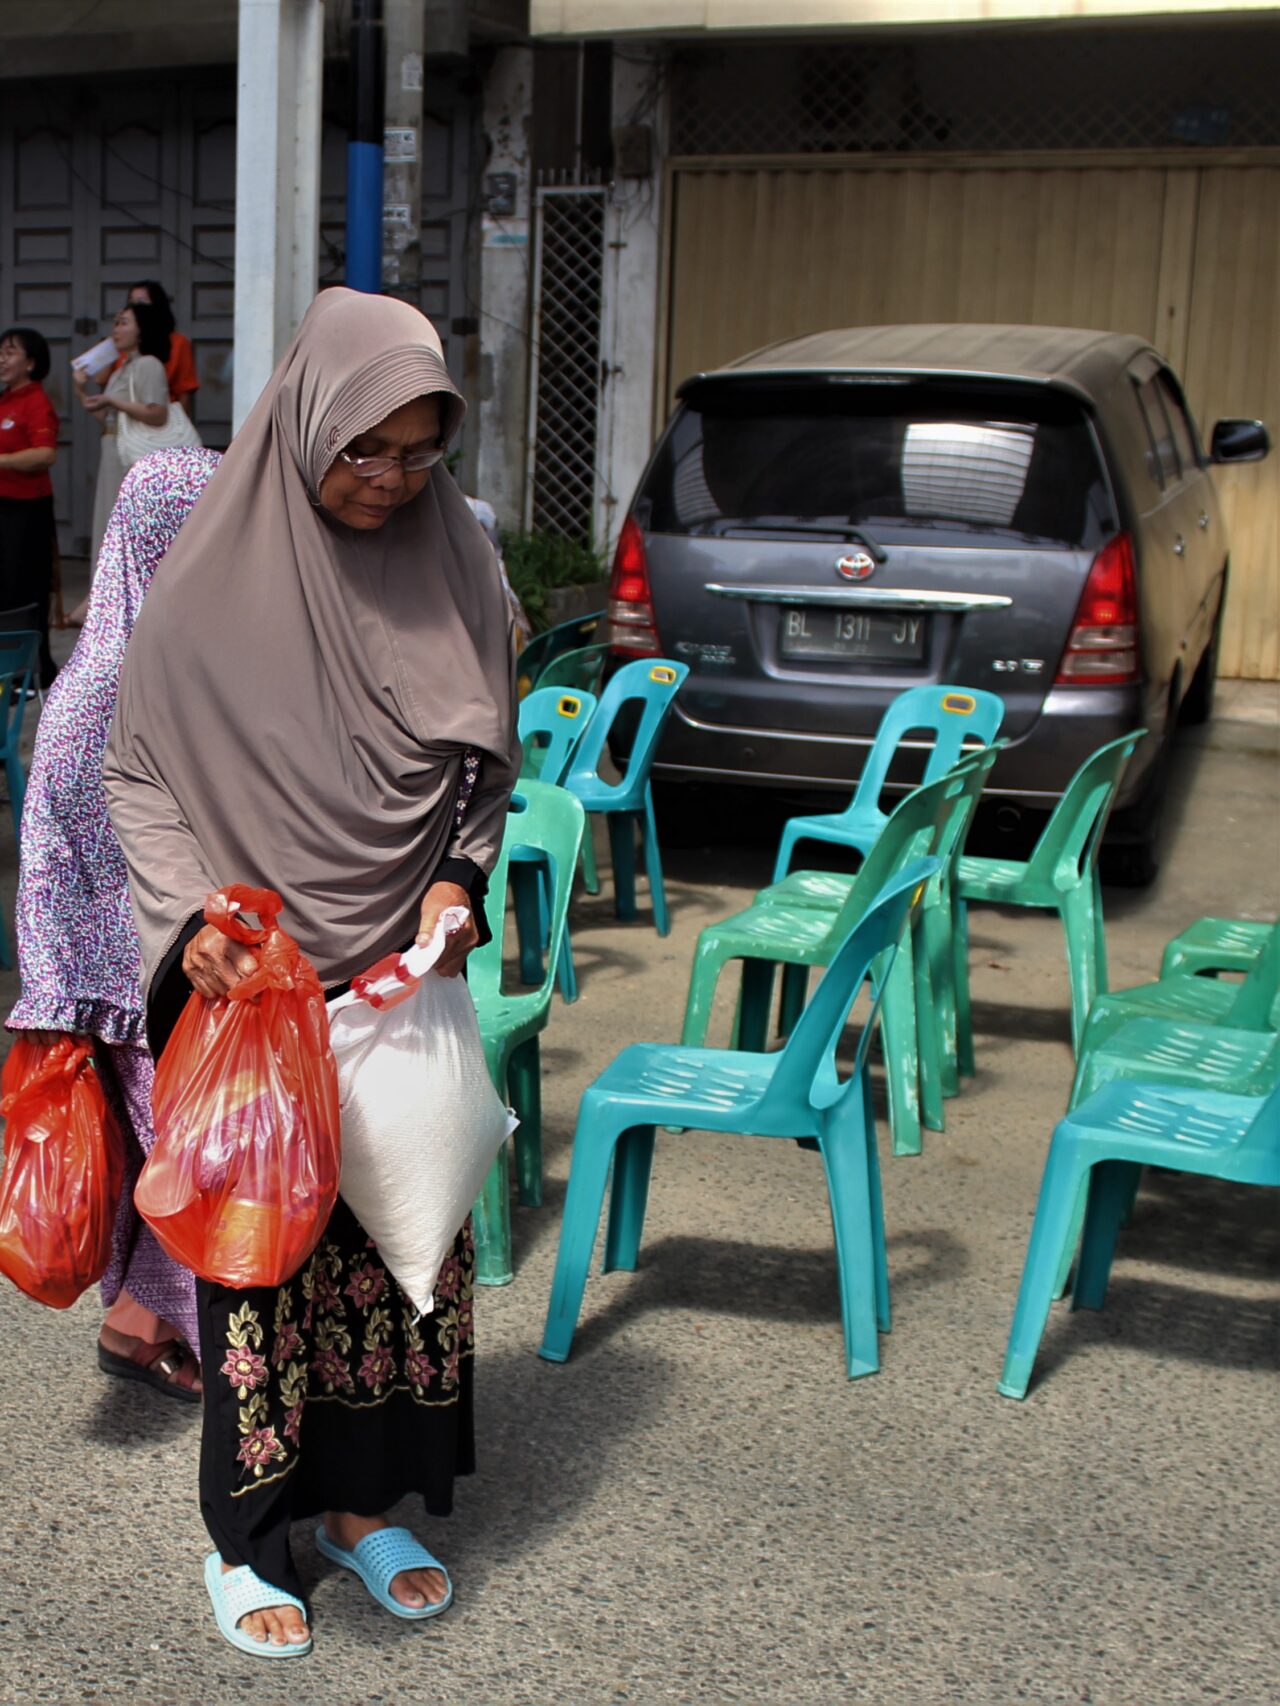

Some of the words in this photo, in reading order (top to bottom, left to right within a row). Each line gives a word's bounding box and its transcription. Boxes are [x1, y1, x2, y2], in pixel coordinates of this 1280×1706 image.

[787, 610, 811, 637] BL
[834, 612, 870, 641] 1311
[893, 614, 920, 645] JY
